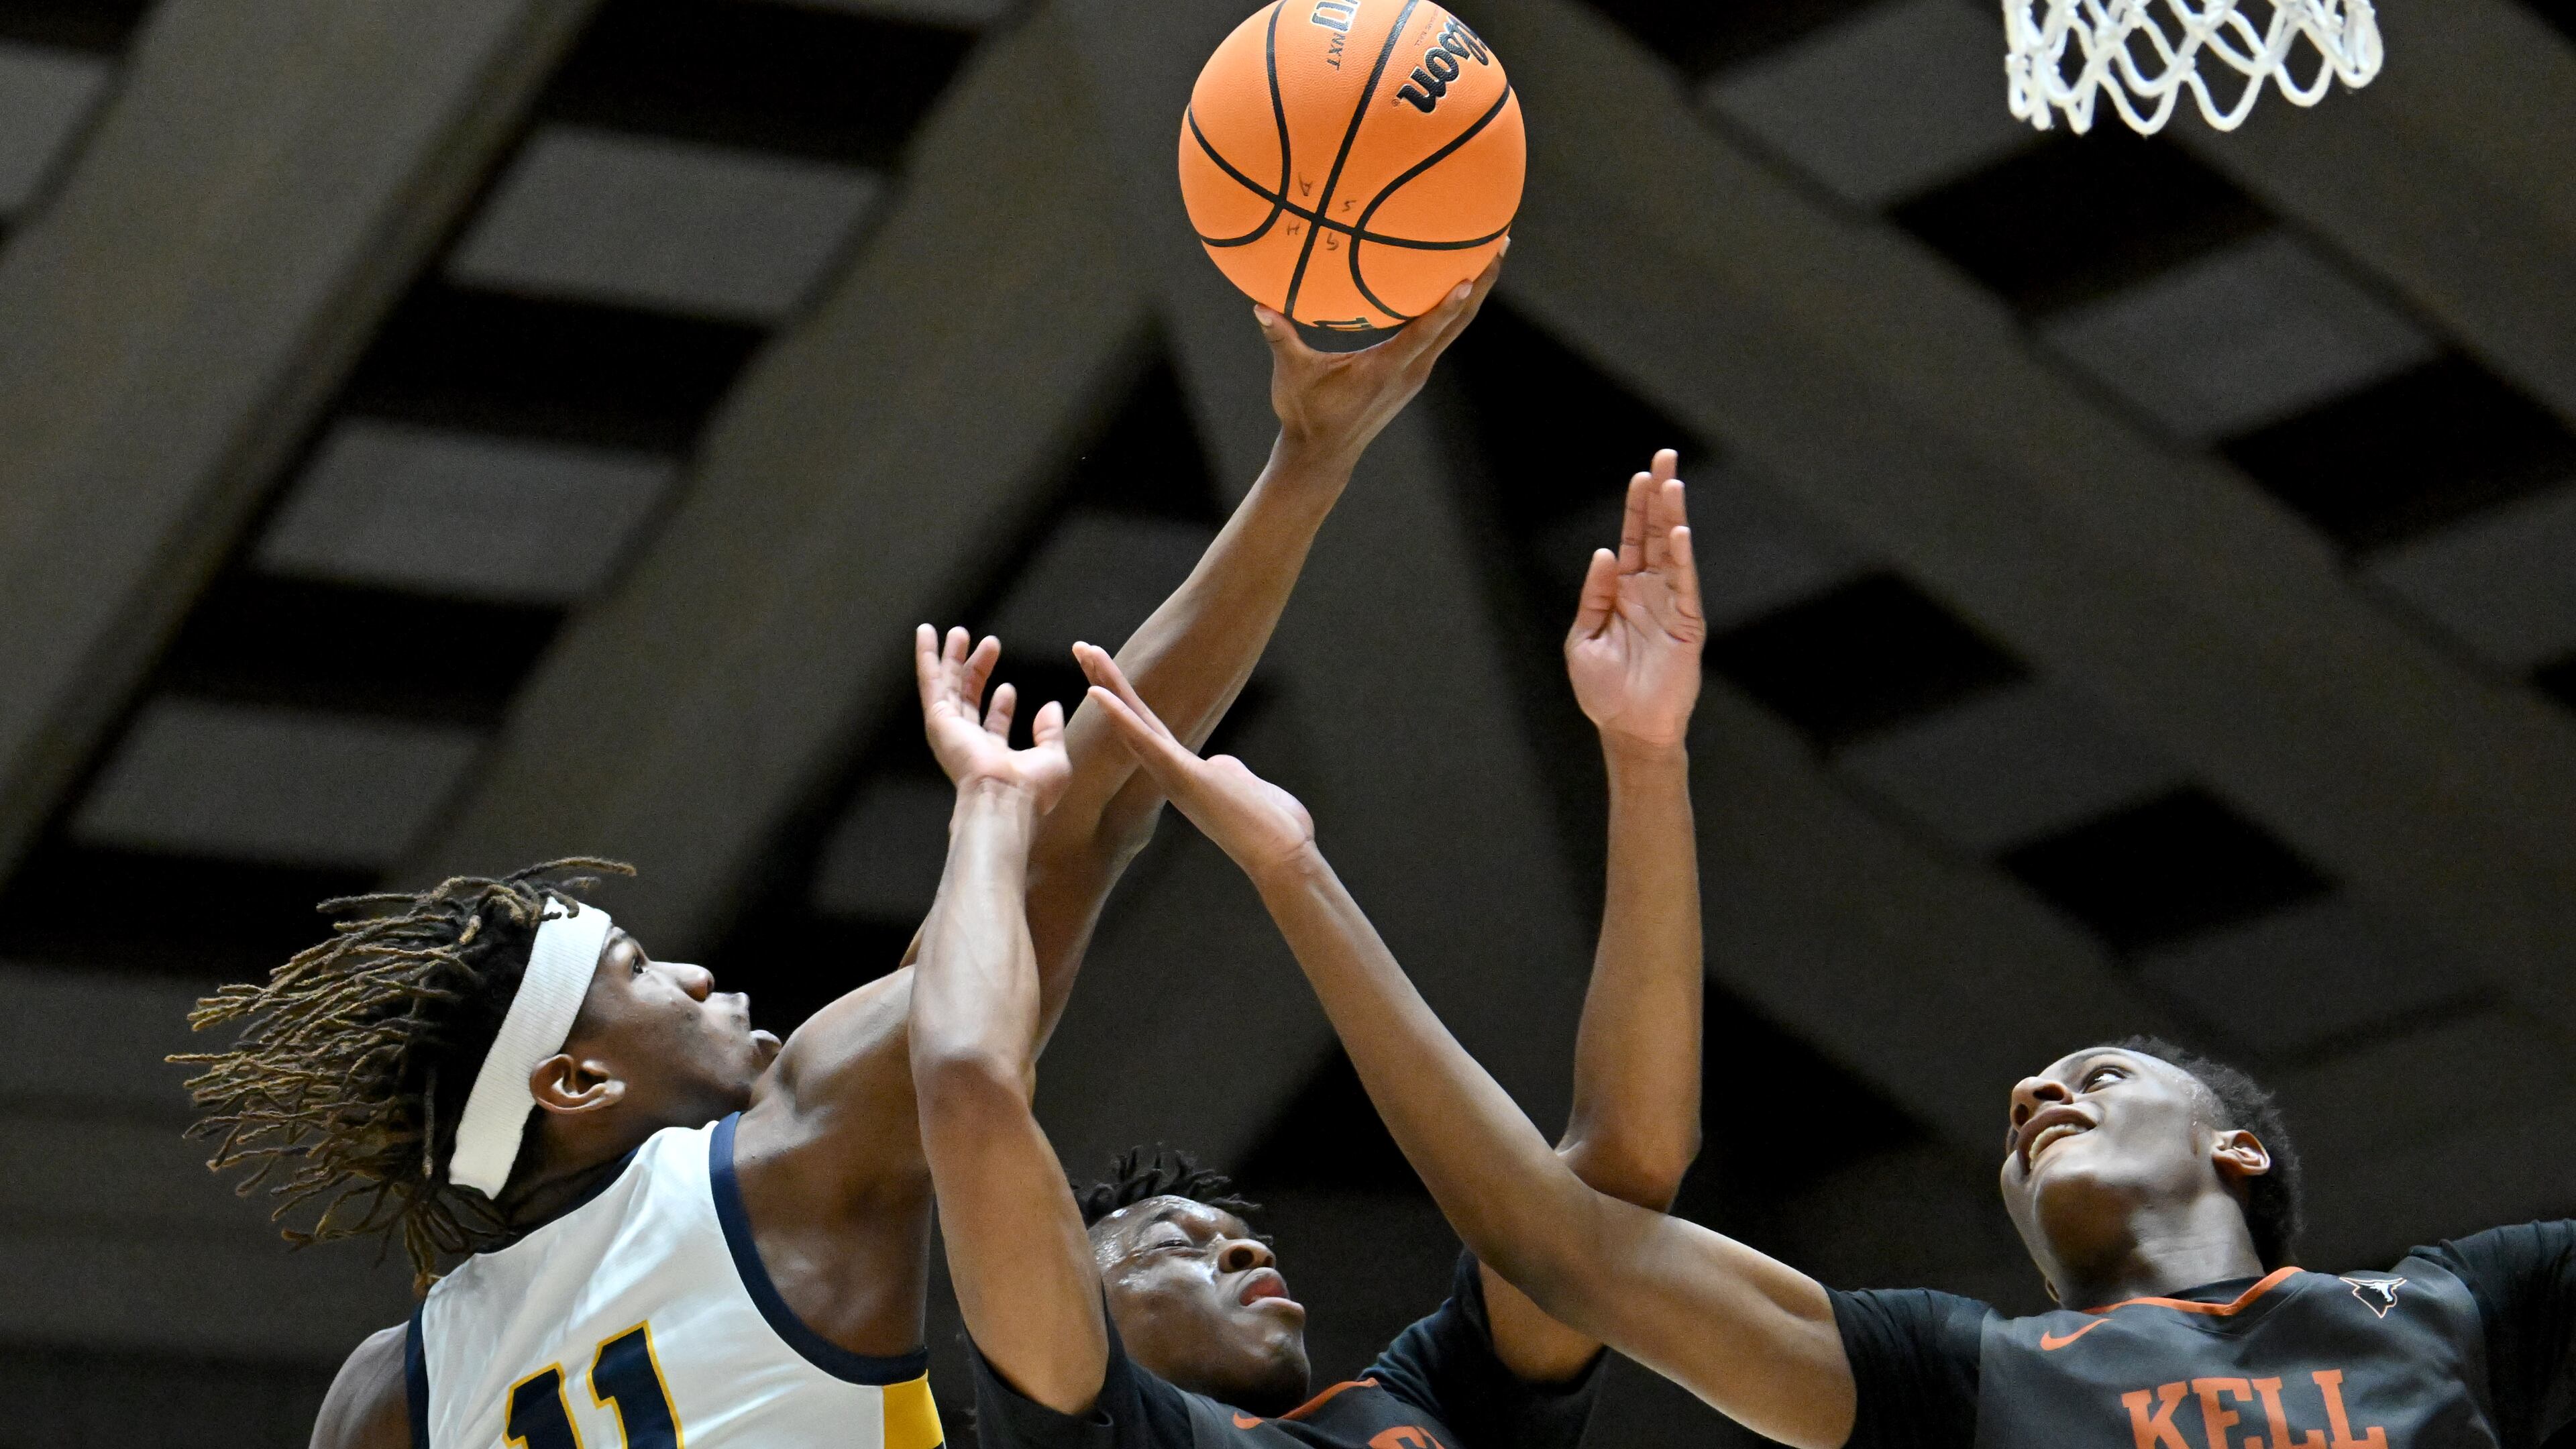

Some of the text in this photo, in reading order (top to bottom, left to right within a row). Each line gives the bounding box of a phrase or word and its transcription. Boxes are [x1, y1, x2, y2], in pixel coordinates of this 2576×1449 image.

[1327, 32, 1346, 70] NXT
[1395, 15, 1489, 113] ilson
[2121, 1368, 2389, 1449] KELL
